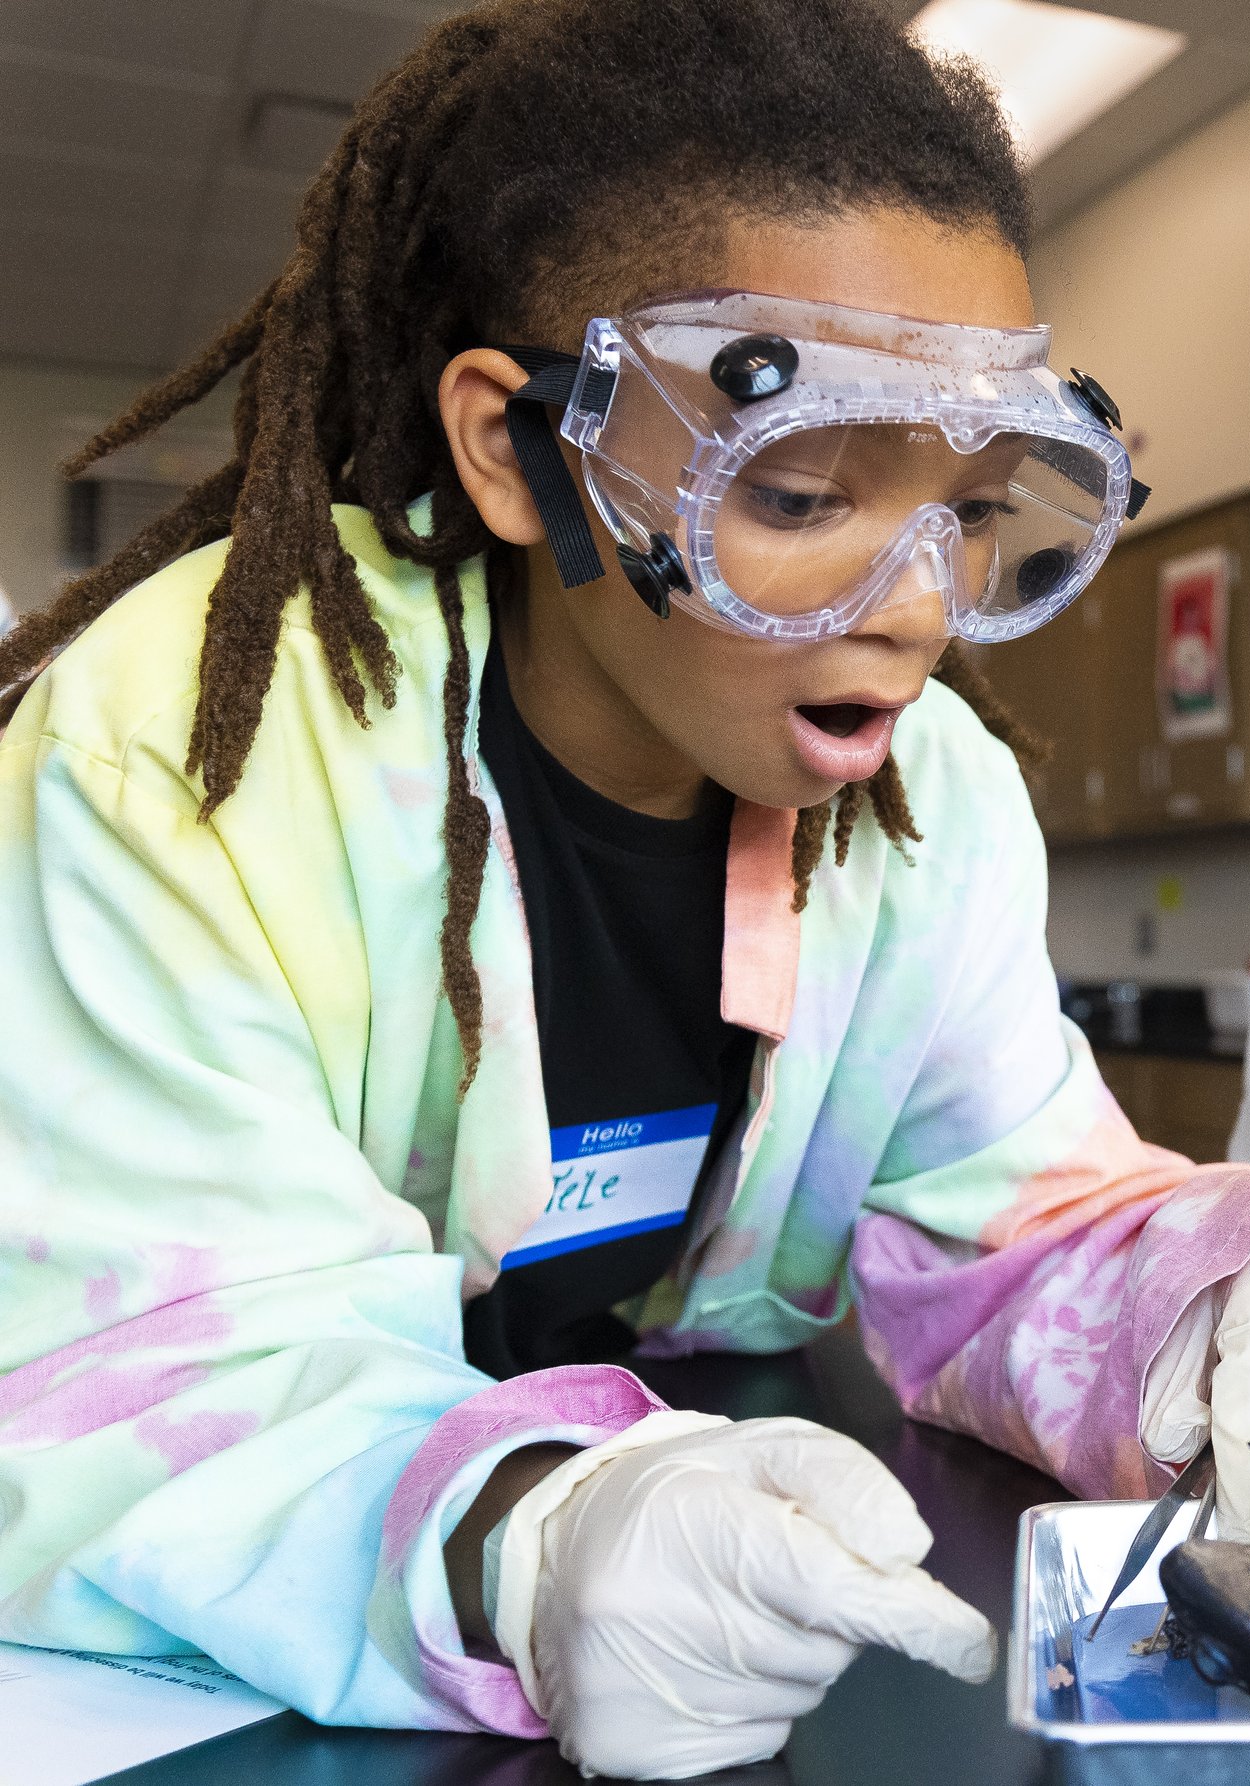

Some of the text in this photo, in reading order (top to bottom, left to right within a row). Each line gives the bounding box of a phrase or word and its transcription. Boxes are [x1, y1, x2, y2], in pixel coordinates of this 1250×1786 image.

[581, 1121, 643, 1145] Hello
[139, 1671, 167, 1680] will
[164, 1676, 186, 1685] we
[183, 1681, 222, 1694] Today
